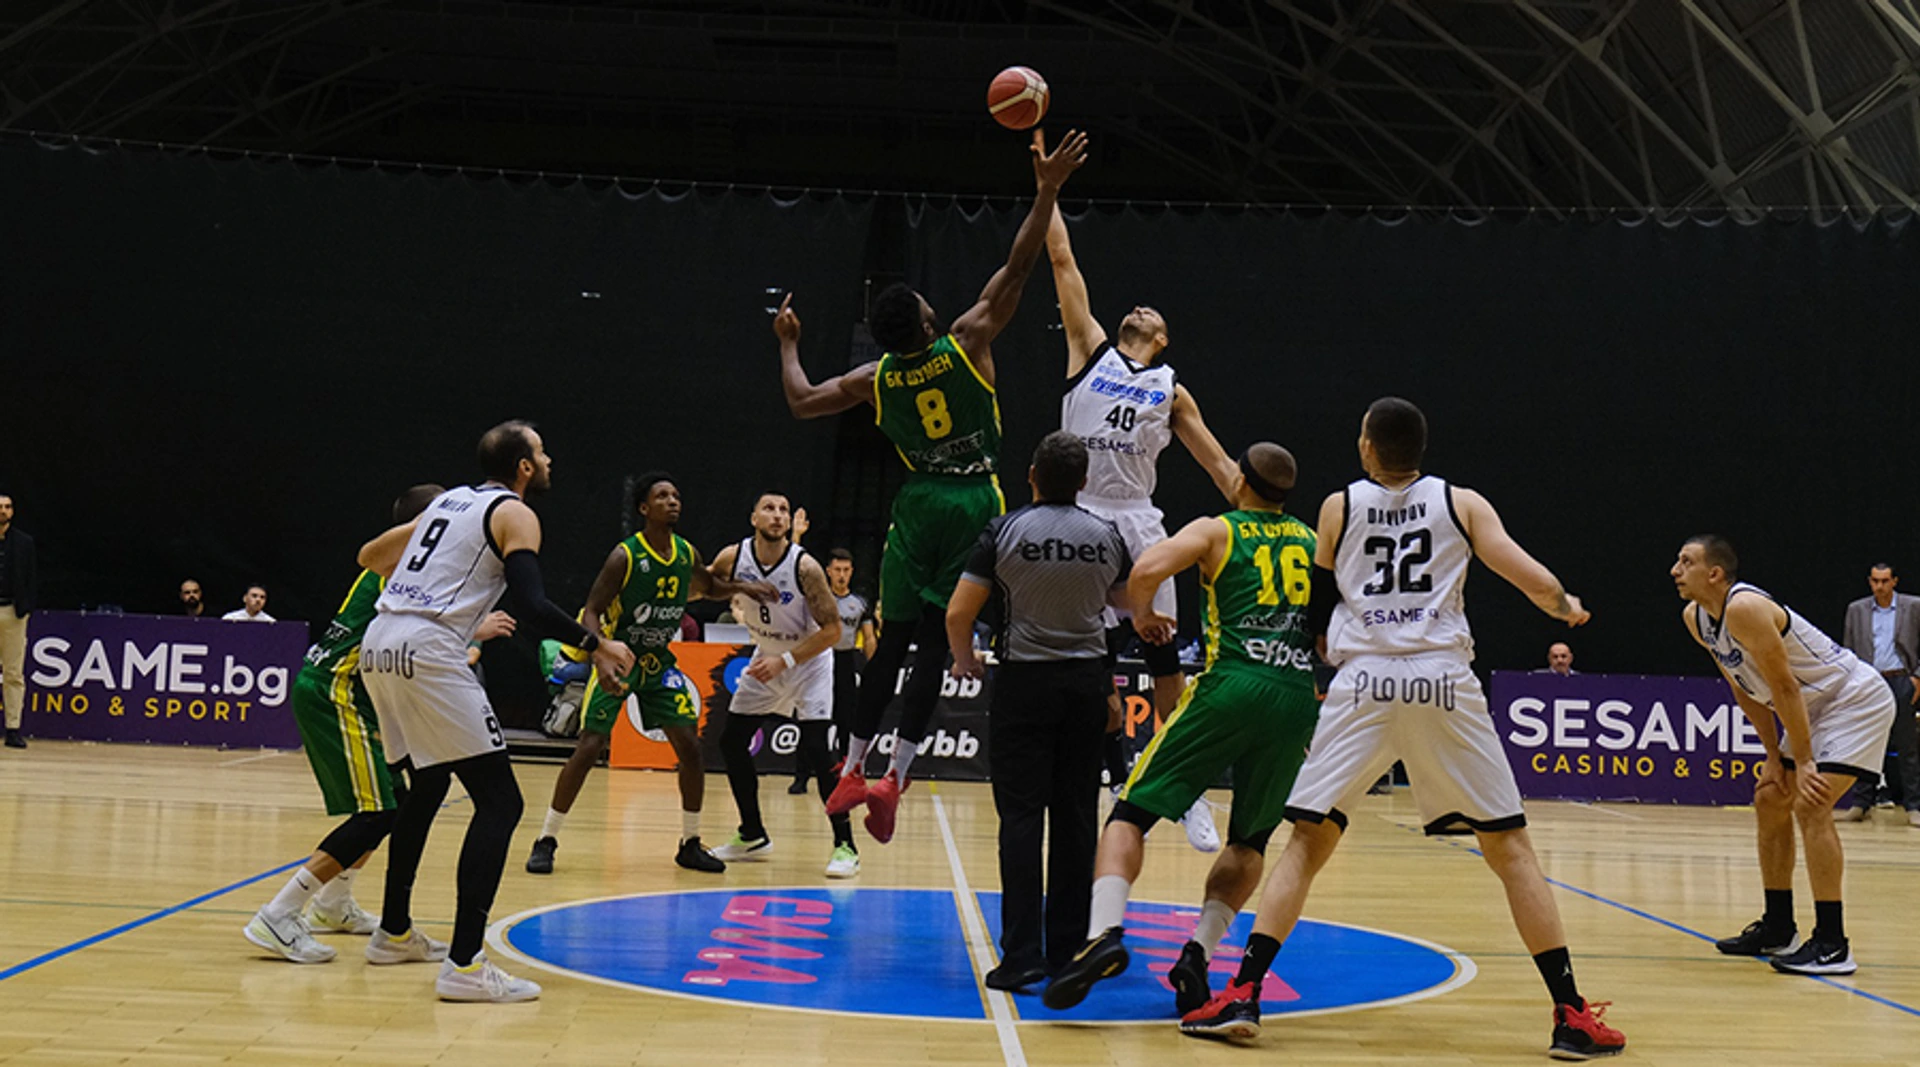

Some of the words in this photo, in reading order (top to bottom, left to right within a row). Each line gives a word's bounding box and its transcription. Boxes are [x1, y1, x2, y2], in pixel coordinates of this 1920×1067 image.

[915, 388, 953, 439] 8
[1105, 404, 1136, 432] 40
[1367, 503, 1426, 526] DAVIDOV
[407, 518, 450, 572] 9
[1020, 538, 1108, 565] efbet
[1254, 544, 1311, 607] 16
[1363, 528, 1432, 596] 32
[759, 604, 771, 624] 8
[1244, 638, 1313, 671] efbe
[31, 637, 289, 706] SAME.bg
[32, 693, 90, 714] INO
[108, 696, 125, 716] &
[144, 698, 251, 722] SPORT
[485, 716, 503, 747] 9
[1508, 698, 1768, 754] SESAME
[1531, 753, 1655, 777] CASINO
[1674, 758, 1690, 778] &
[1709, 760, 1766, 779] SPO
